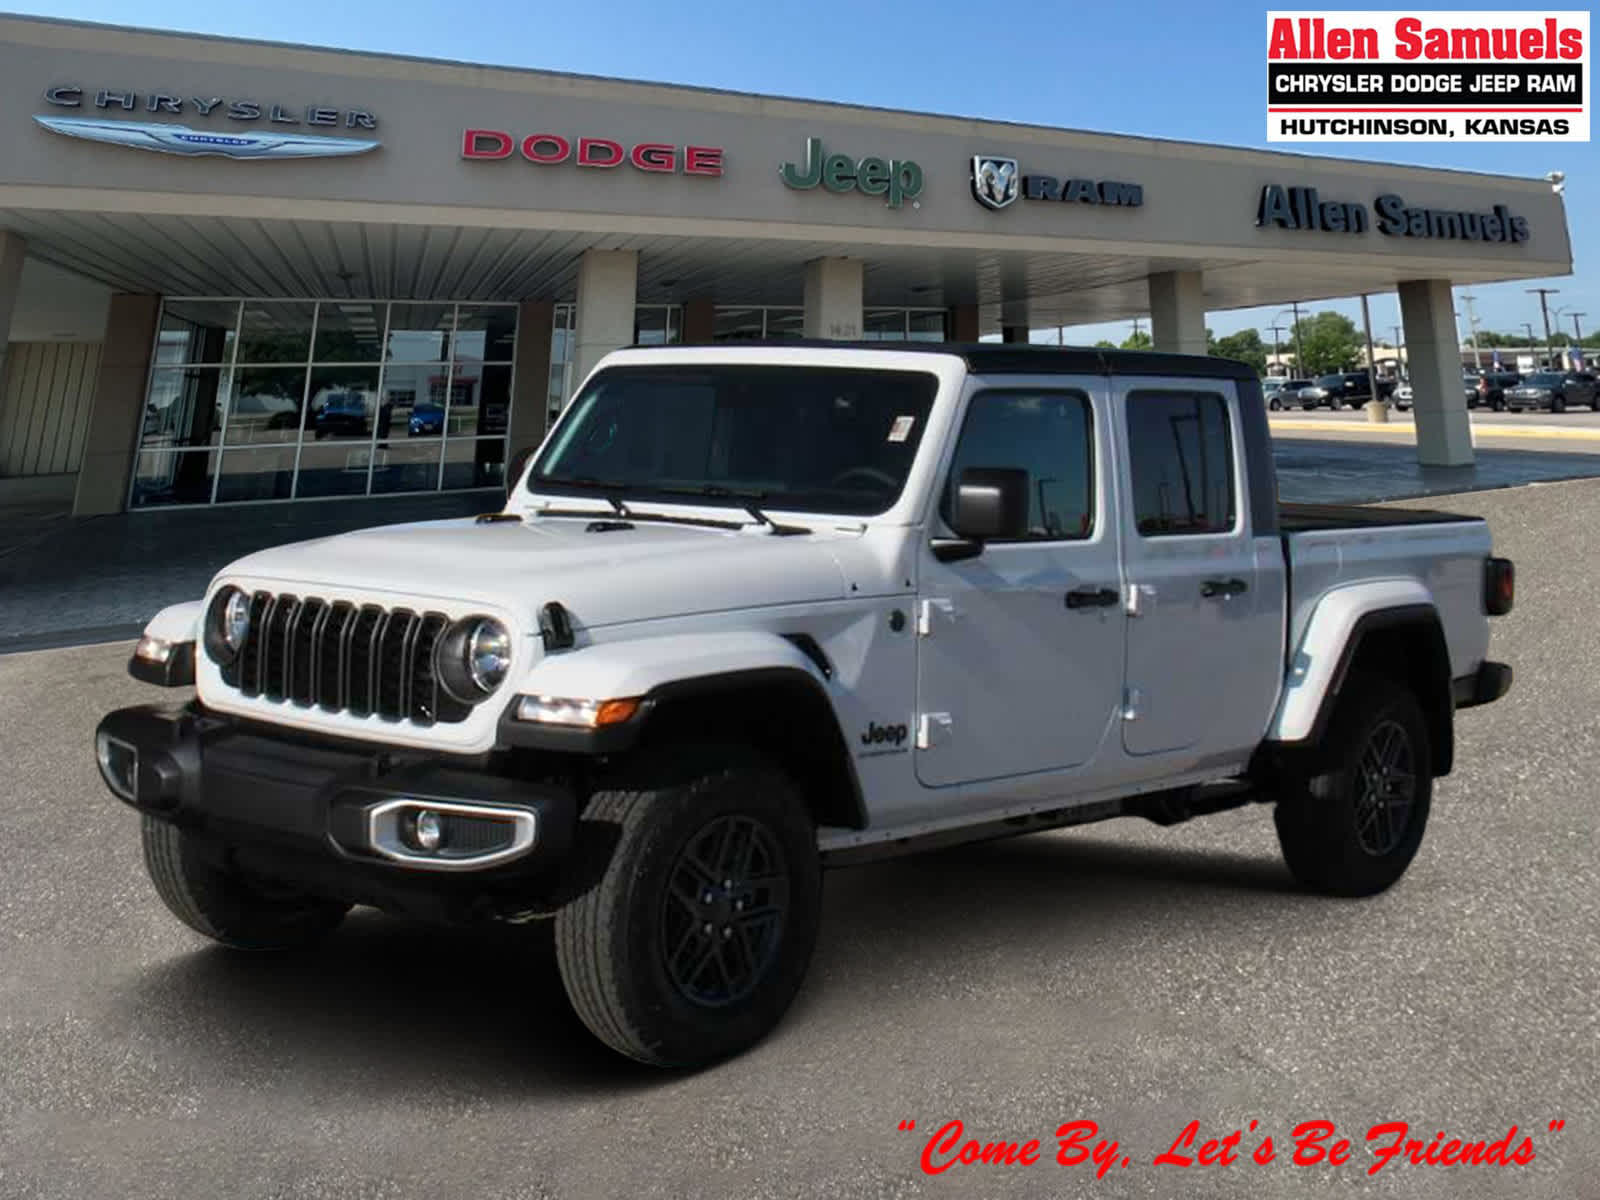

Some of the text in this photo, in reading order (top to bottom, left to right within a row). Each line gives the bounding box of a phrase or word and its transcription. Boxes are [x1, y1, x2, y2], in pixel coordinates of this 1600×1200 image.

[44, 86, 377, 129] CHRYSLER
[462, 128, 725, 177] DODGE
[779, 136, 924, 210] Jeep
[1022, 175, 1144, 207] RAM
[1256, 184, 1530, 244] Allen Samuels
[861, 720, 908, 747] Jeep
